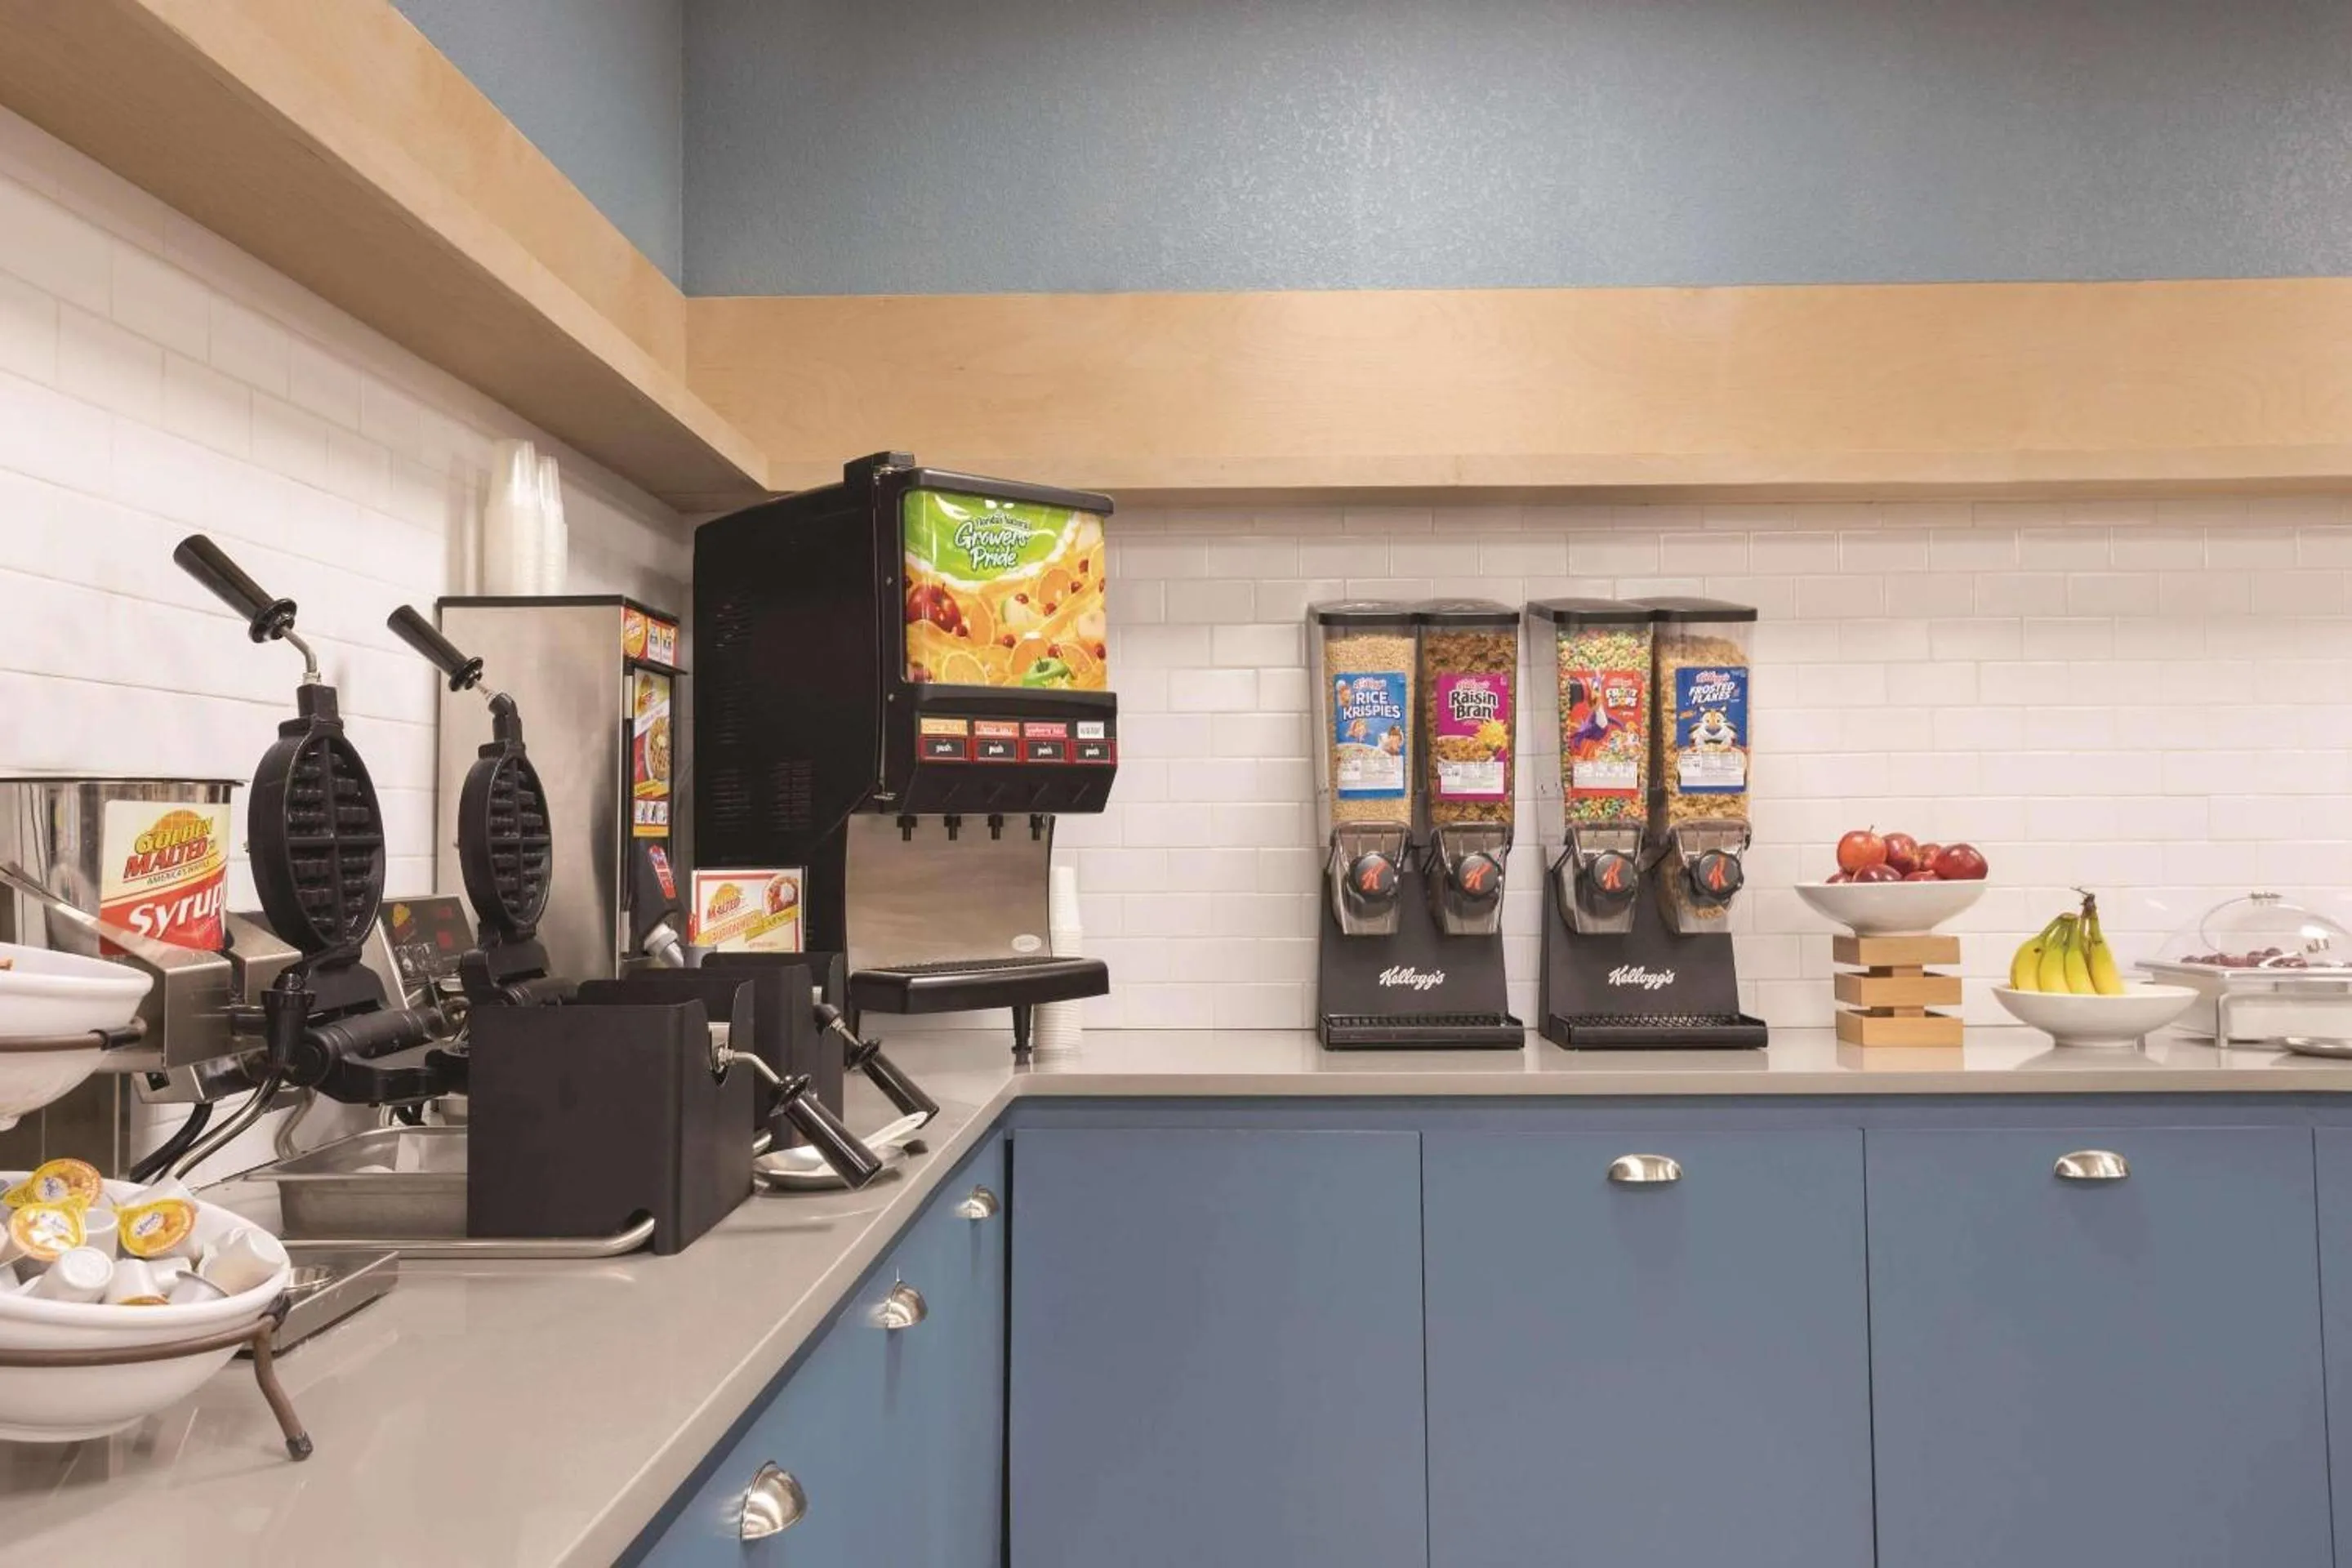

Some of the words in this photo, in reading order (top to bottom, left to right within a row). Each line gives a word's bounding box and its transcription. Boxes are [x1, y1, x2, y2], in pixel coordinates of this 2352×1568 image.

[969, 546, 1018, 571] Pride
[1689, 681, 1735, 697] FROSTED
[1356, 691, 1388, 705] RICE
[1450, 691, 1497, 706] Raisin
[1691, 691, 1730, 705] FLAKES
[1343, 705, 1401, 719] KRISPIES
[1456, 705, 1492, 719] Bran
[123, 837, 209, 880] MALTED
[128, 883, 225, 938] Syrup
[1379, 965, 1446, 991] Kellogg's
[1609, 964, 1676, 990] Kellogg's
